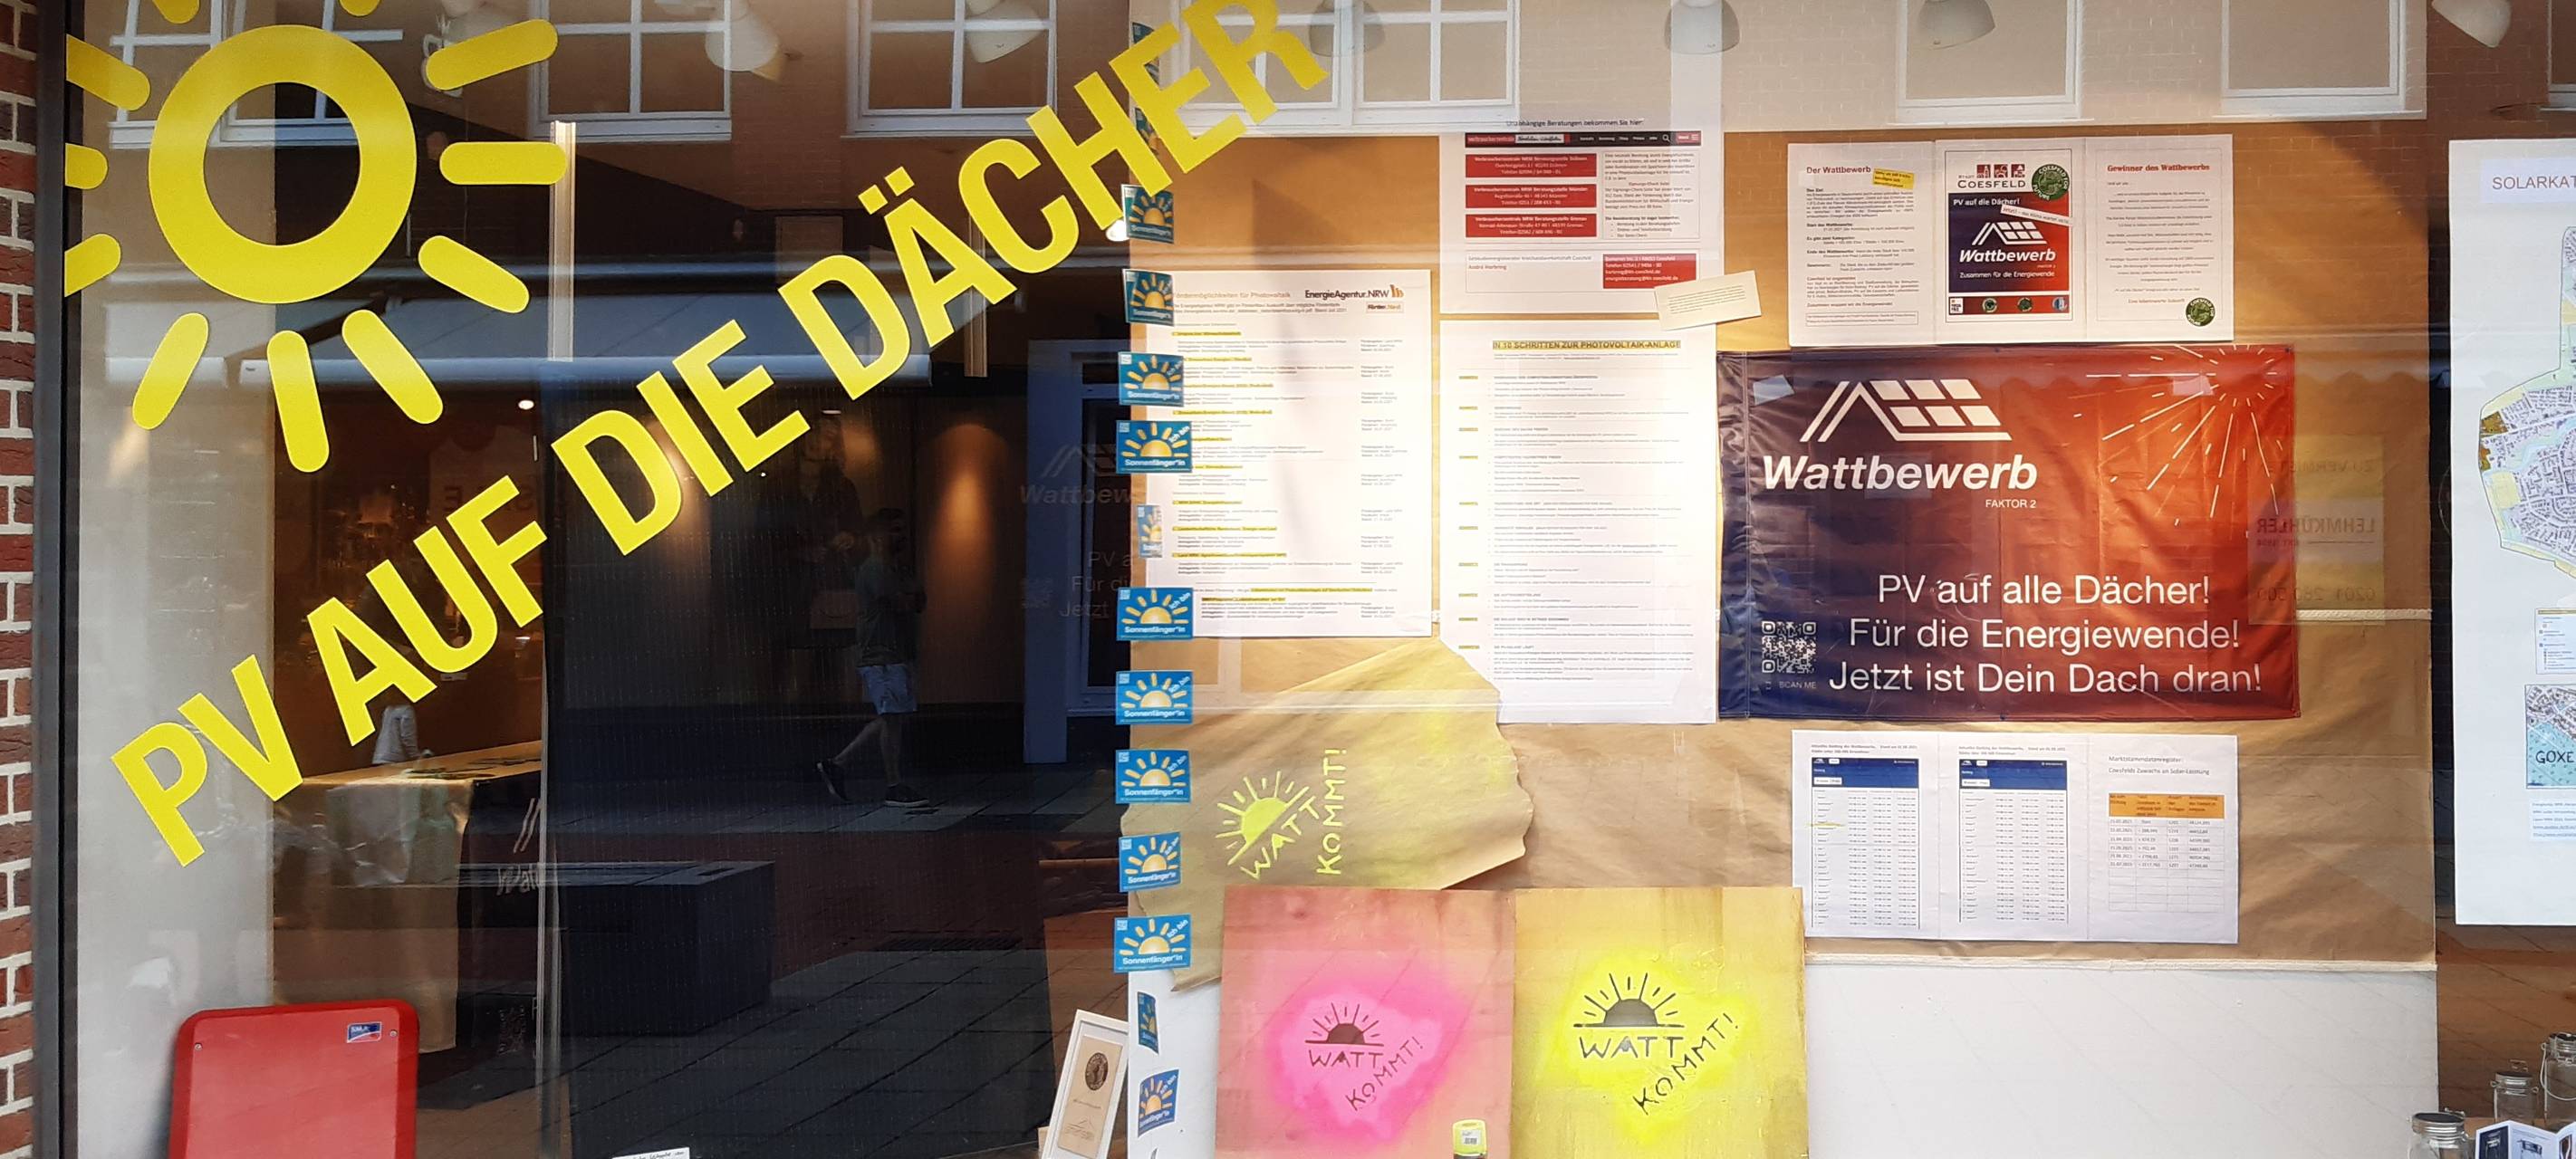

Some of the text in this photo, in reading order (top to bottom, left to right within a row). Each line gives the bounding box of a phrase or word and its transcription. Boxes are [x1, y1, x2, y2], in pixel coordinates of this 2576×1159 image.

[1957, 180, 2025, 188] COESFELD
[1959, 248, 2056, 263] Wattbewerb
[1305, 290, 1389, 300] EnergieAgentur.NRW
[111, 0, 1328, 867] PV AUF DIE DÄCHER
[1763, 454, 2038, 491] Wattbewerb
[1985, 499, 2037, 509] FAKTOR 2
[1879, 574, 2210, 605] PV auf alle Dächer!
[1849, 618, 2240, 656] Für die Energiewende!
[1778, 680, 1817, 689] SCAN ME
[1829, 661, 2262, 694] Jetzt ist Dein Dach dran!
[2535, 750, 2575, 764] GOXE
[1316, 747, 1348, 875] KOMMT!
[1241, 795, 1322, 881] WATT
[1308, 1049, 1384, 1068] WATT
[1579, 1035, 1684, 1060] WATT
[1345, 1035, 1425, 1112] KOMMT!
[1631, 1011, 1740, 1116] KOMMT!
